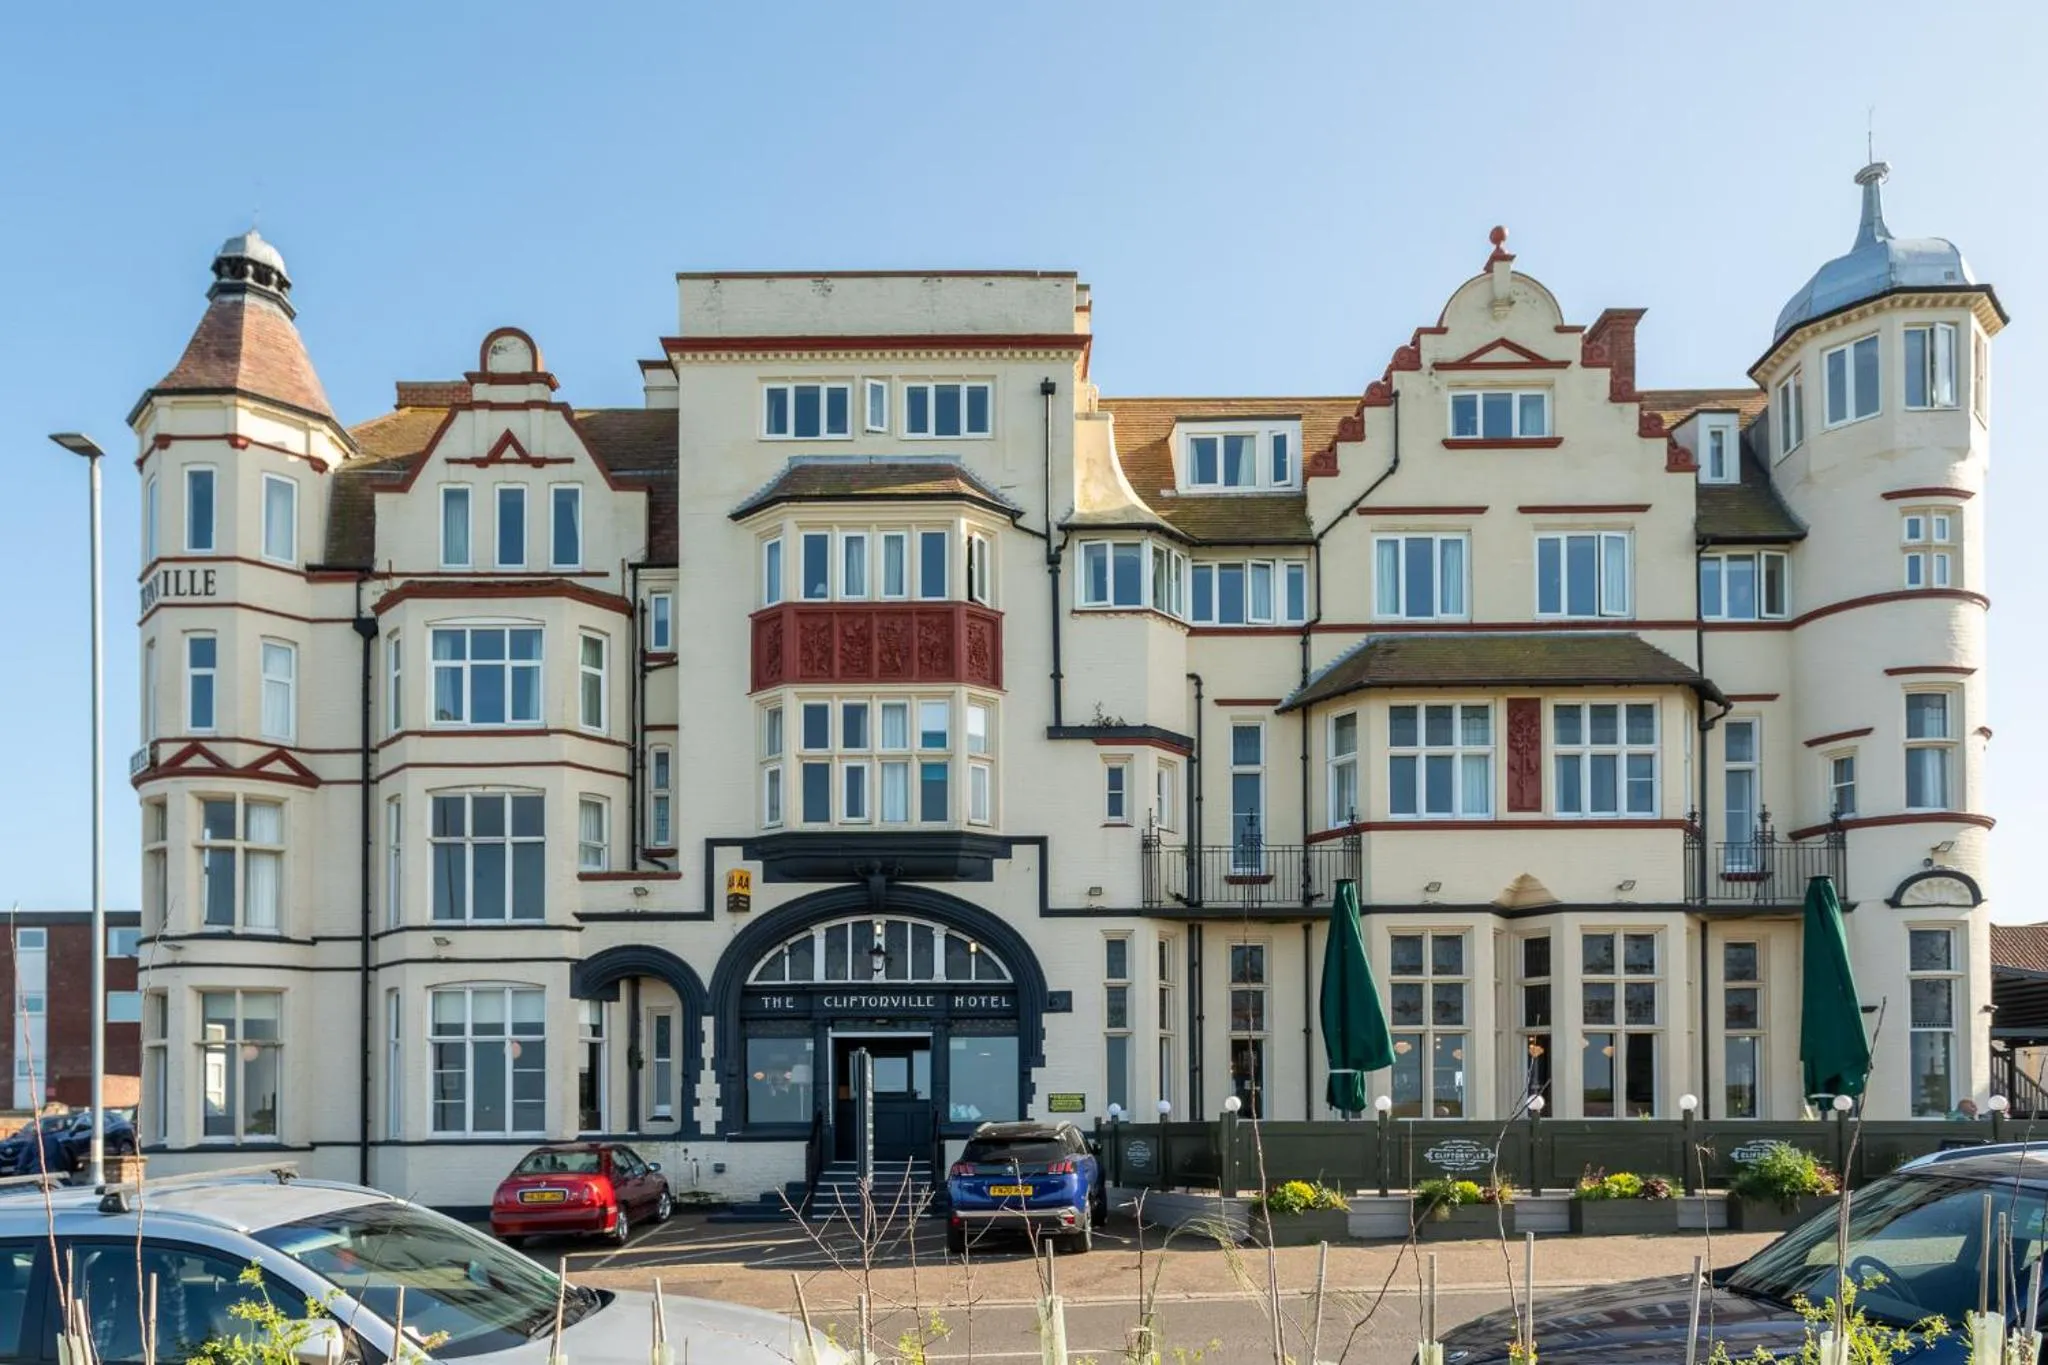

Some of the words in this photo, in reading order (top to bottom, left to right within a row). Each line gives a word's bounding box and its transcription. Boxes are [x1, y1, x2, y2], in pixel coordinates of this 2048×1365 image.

[761, 996, 794, 1009] THE
[823, 995, 935, 1008] CLIFTONVILLE
[954, 995, 1011, 1008] HOTEL
